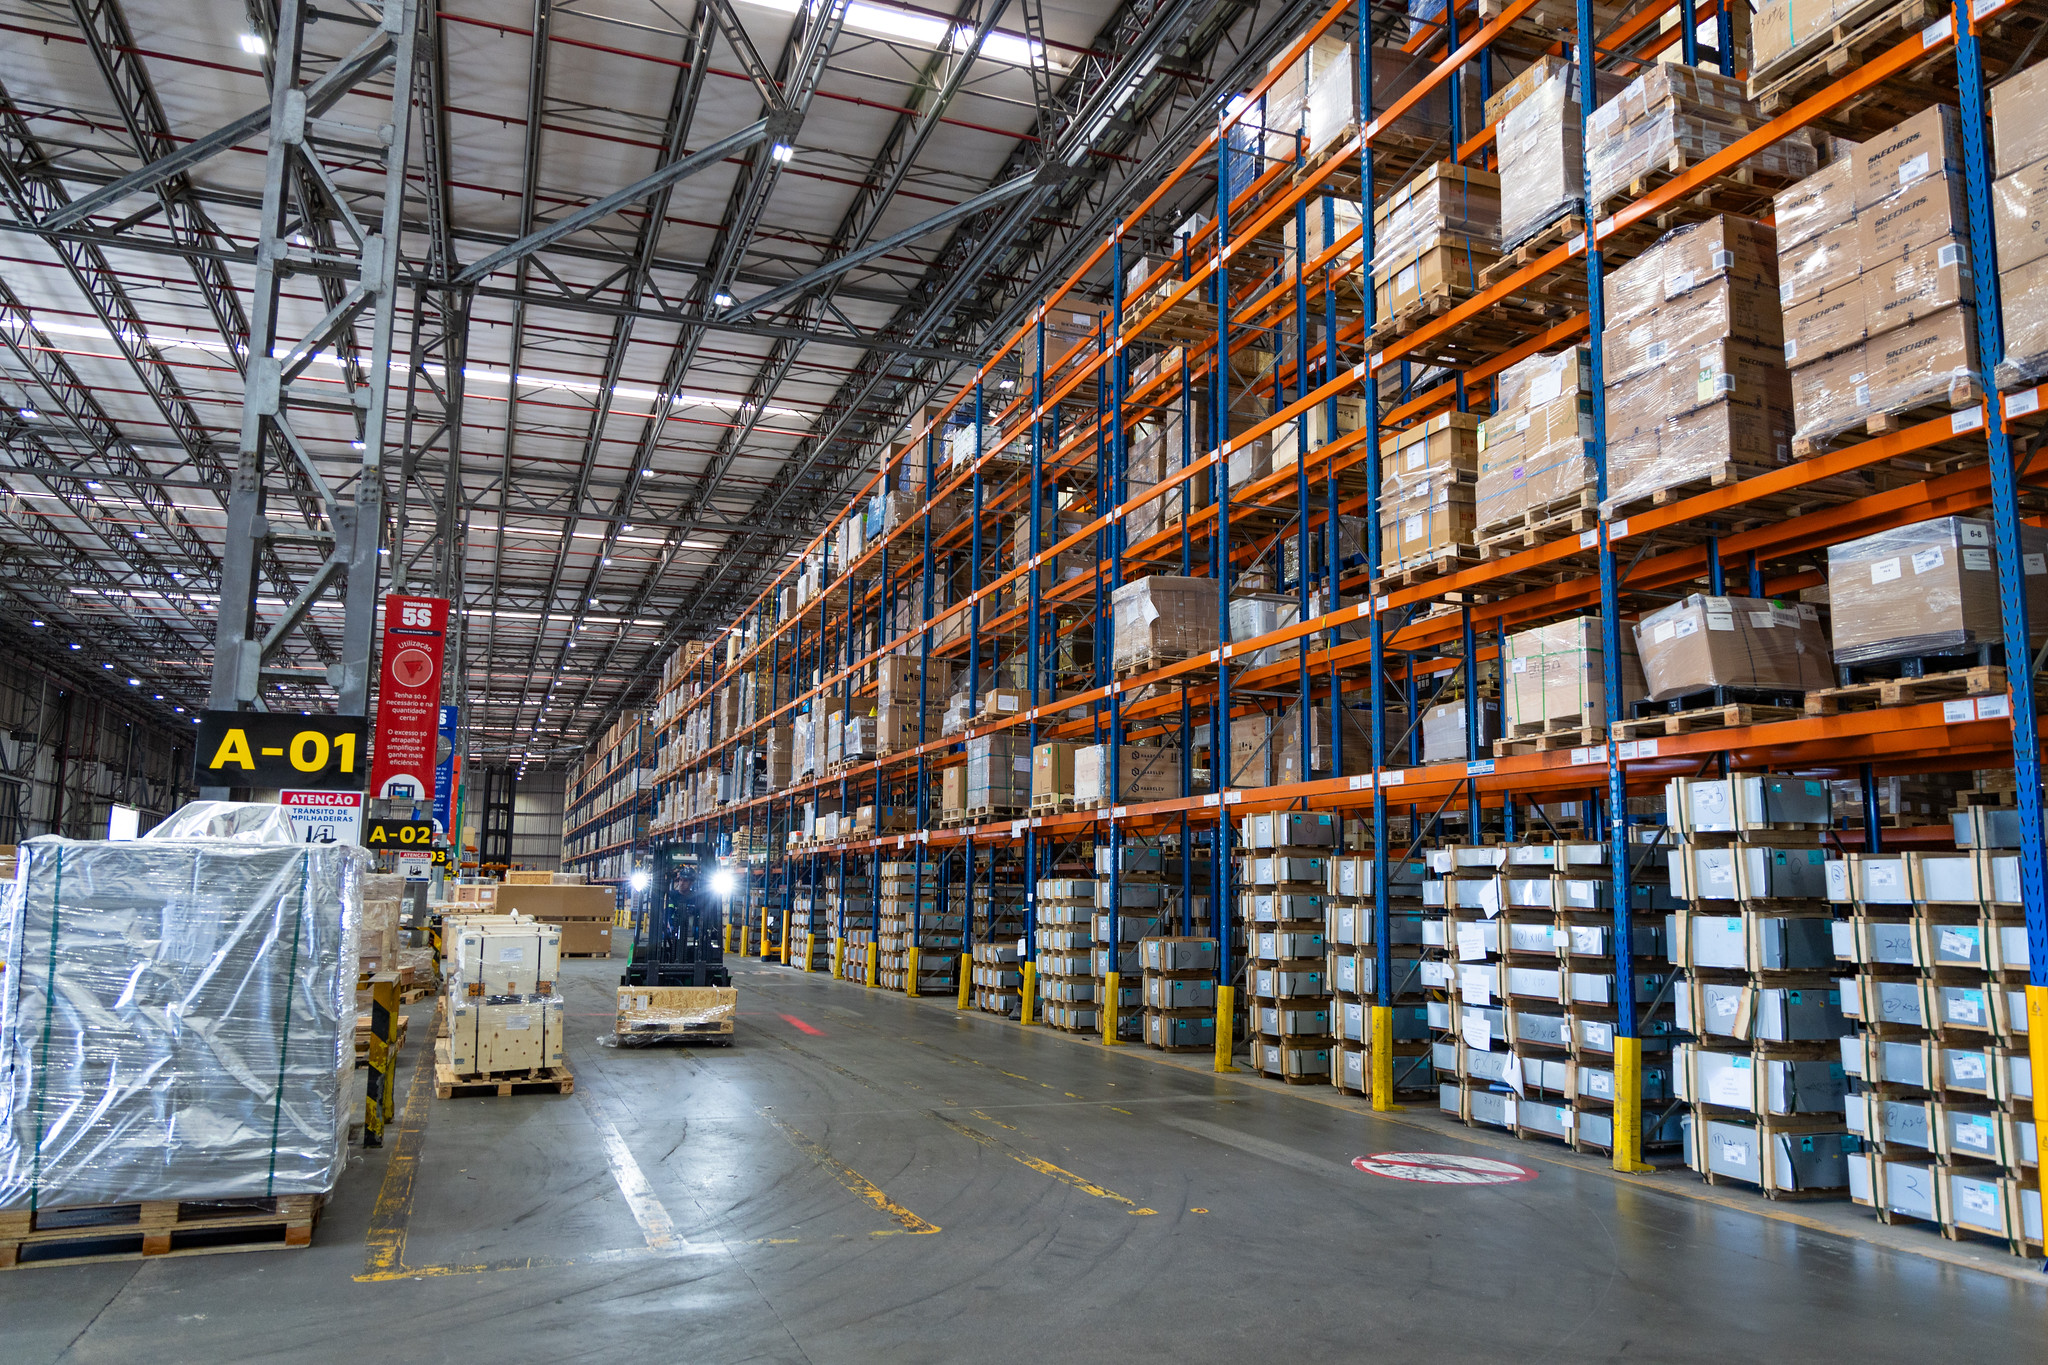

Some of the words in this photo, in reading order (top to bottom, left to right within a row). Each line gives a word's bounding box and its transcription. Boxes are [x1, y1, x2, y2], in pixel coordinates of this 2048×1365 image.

[1699, 369, 1712, 382] 34
[1970, 530, 1982, 538] 6-8
[402, 607, 432, 627] 5S
[398, 640, 432, 652] Utilização
[914, 674, 939, 683] Blmaq
[386, 699, 419, 707] necessário
[392, 707, 427, 715] quantidade
[913, 724, 938, 733] Blmaq
[209, 728, 356, 772] A-01
[289, 794, 354, 806] ATENÇÃO
[293, 807, 335, 815] TRÂNSITO
[369, 825, 431, 844] A-02
